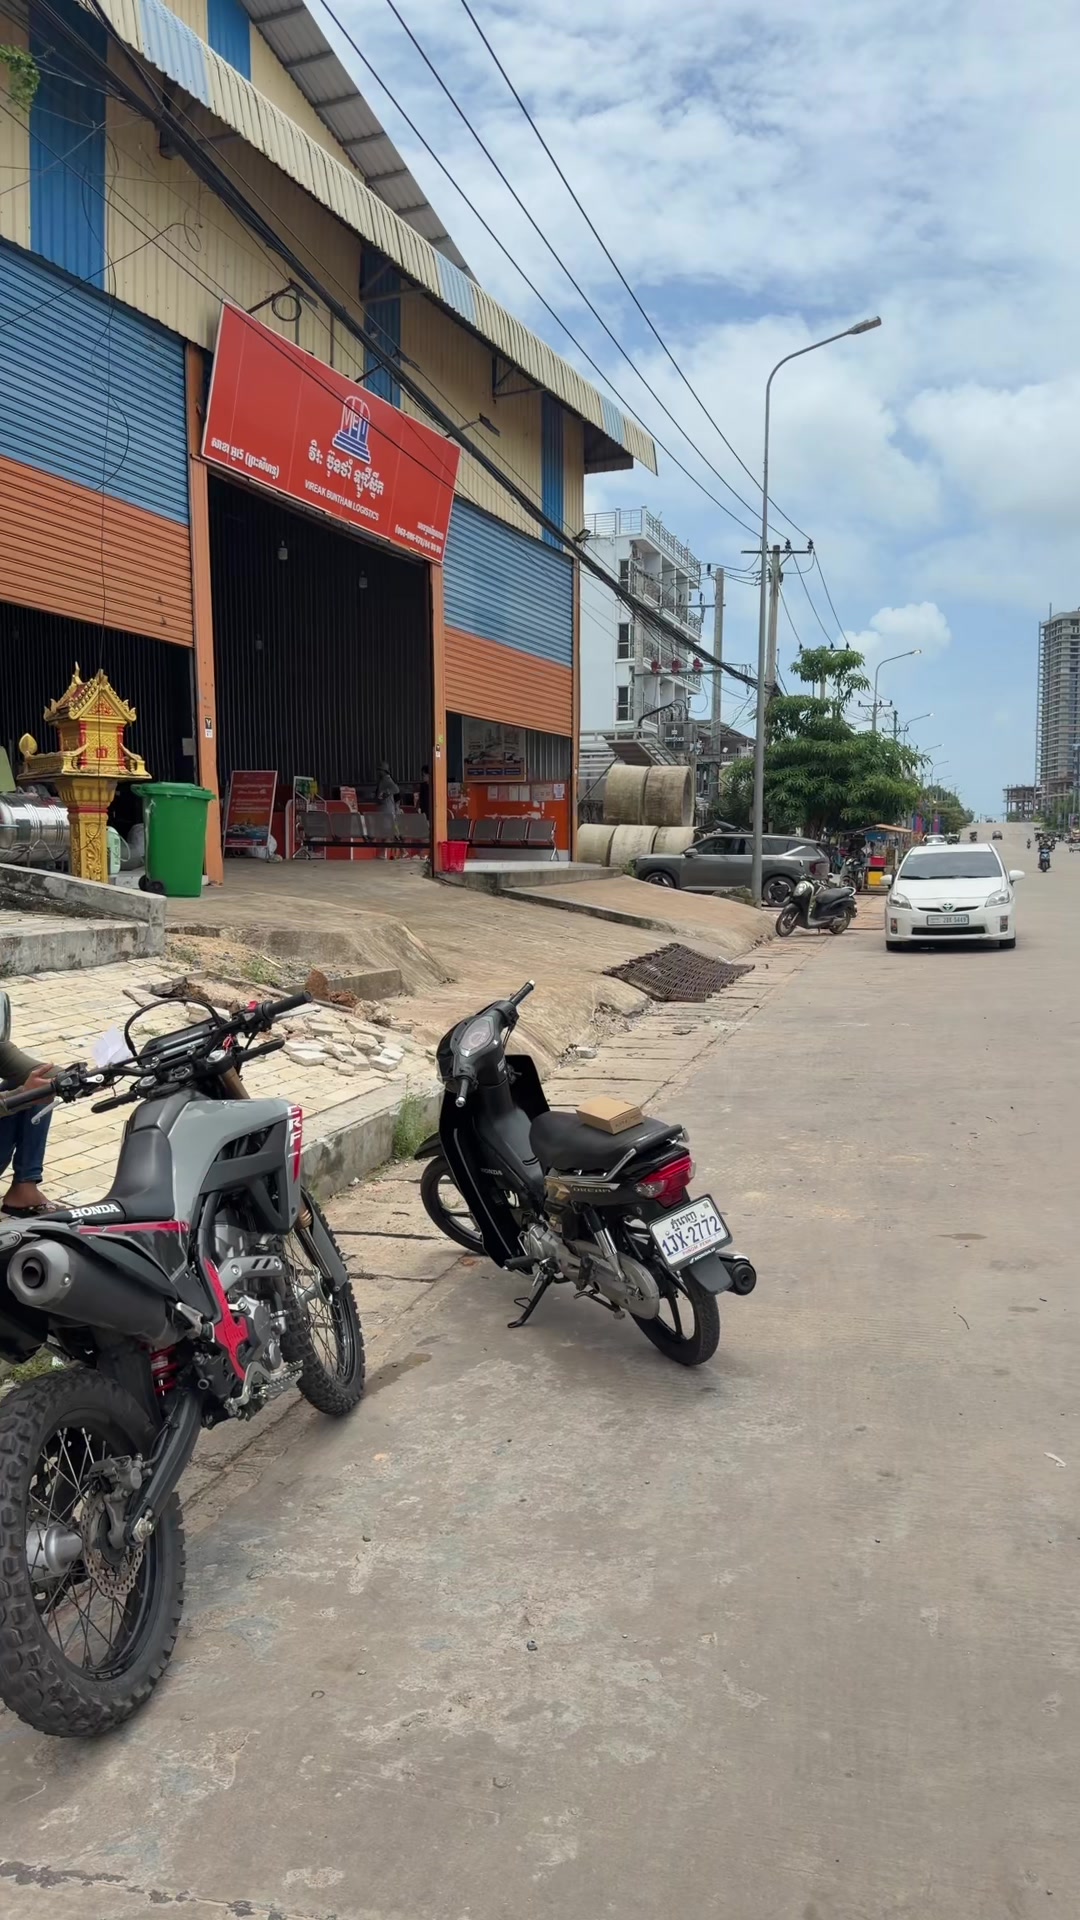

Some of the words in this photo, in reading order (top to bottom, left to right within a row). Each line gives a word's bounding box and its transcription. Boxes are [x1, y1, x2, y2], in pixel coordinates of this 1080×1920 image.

[304, 479, 327, 497] VIREAK
[326, 489, 353, 509] BUNTHAM
[353, 502, 379, 521] LOGISTICS
[69, 1203, 120, 1218] HONDA
[662, 1215, 721, 1256] 1JX-2772
